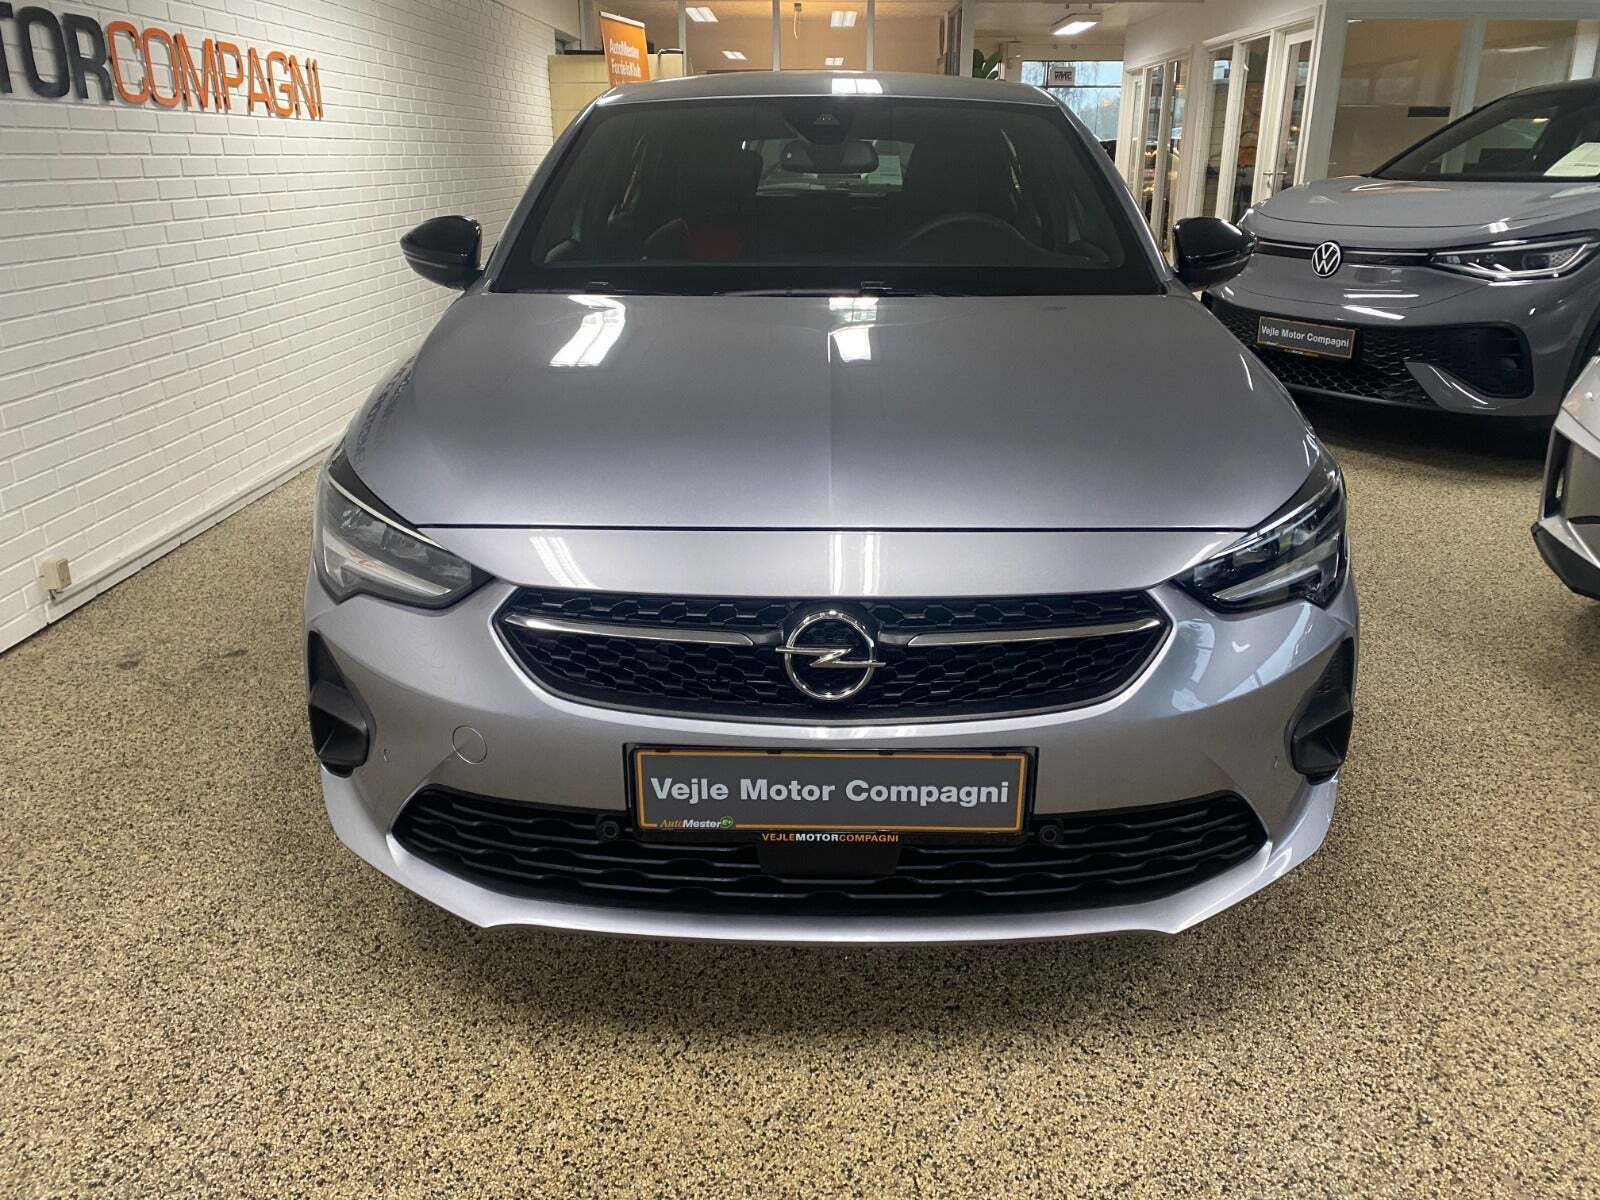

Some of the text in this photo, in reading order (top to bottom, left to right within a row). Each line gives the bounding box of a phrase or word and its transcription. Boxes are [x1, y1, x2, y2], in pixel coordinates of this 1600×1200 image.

[1261, 325, 1350, 348] Vejle Motor Compagni
[650, 777, 1009, 808] Vejle Motor Compagni
[660, 819, 721, 829] AutoMester
